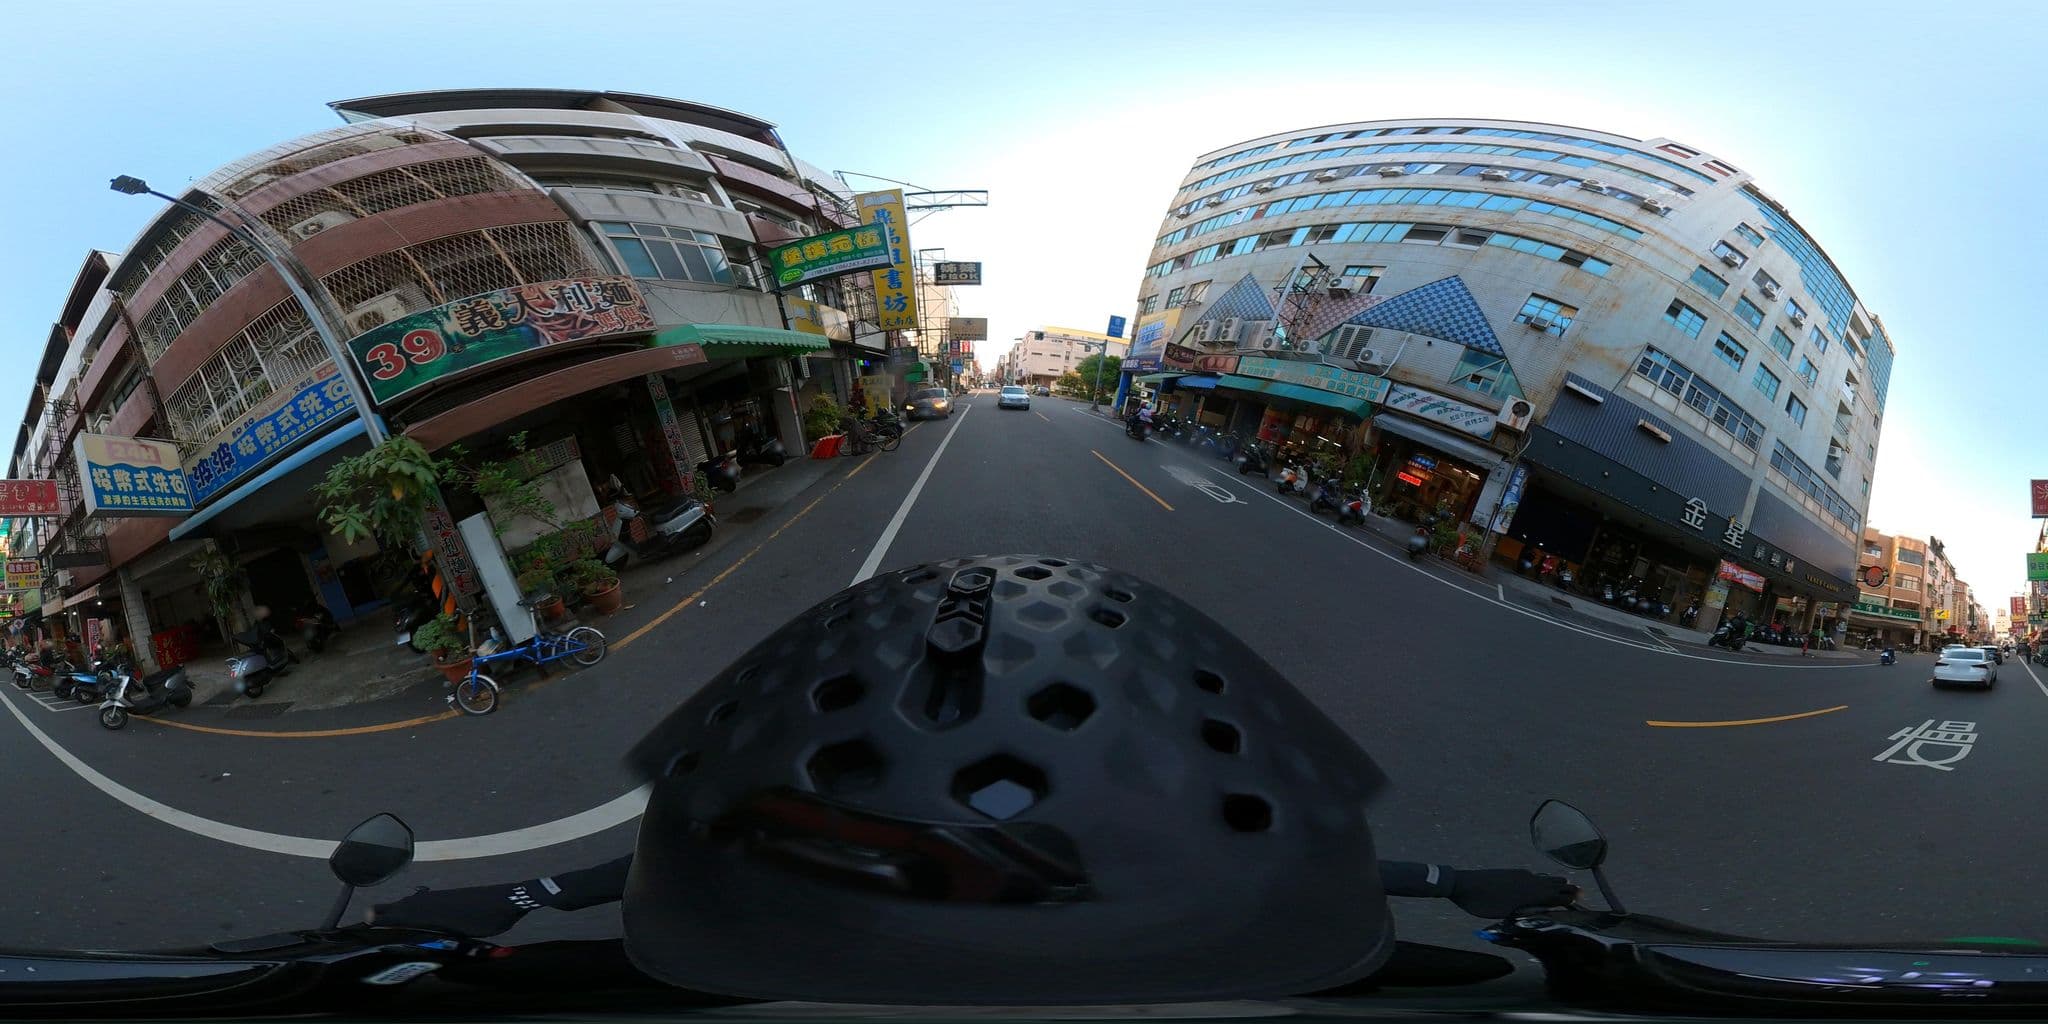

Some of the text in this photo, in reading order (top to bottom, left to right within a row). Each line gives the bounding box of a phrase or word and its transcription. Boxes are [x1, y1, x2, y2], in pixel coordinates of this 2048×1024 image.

[454, 281, 638, 337] 義大利麵
[366, 329, 447, 381] 39
[92, 467, 187, 494] 投幣式洗衣
[1680, 496, 1746, 549] 金星
[1872, 719, 1979, 771] 慢
